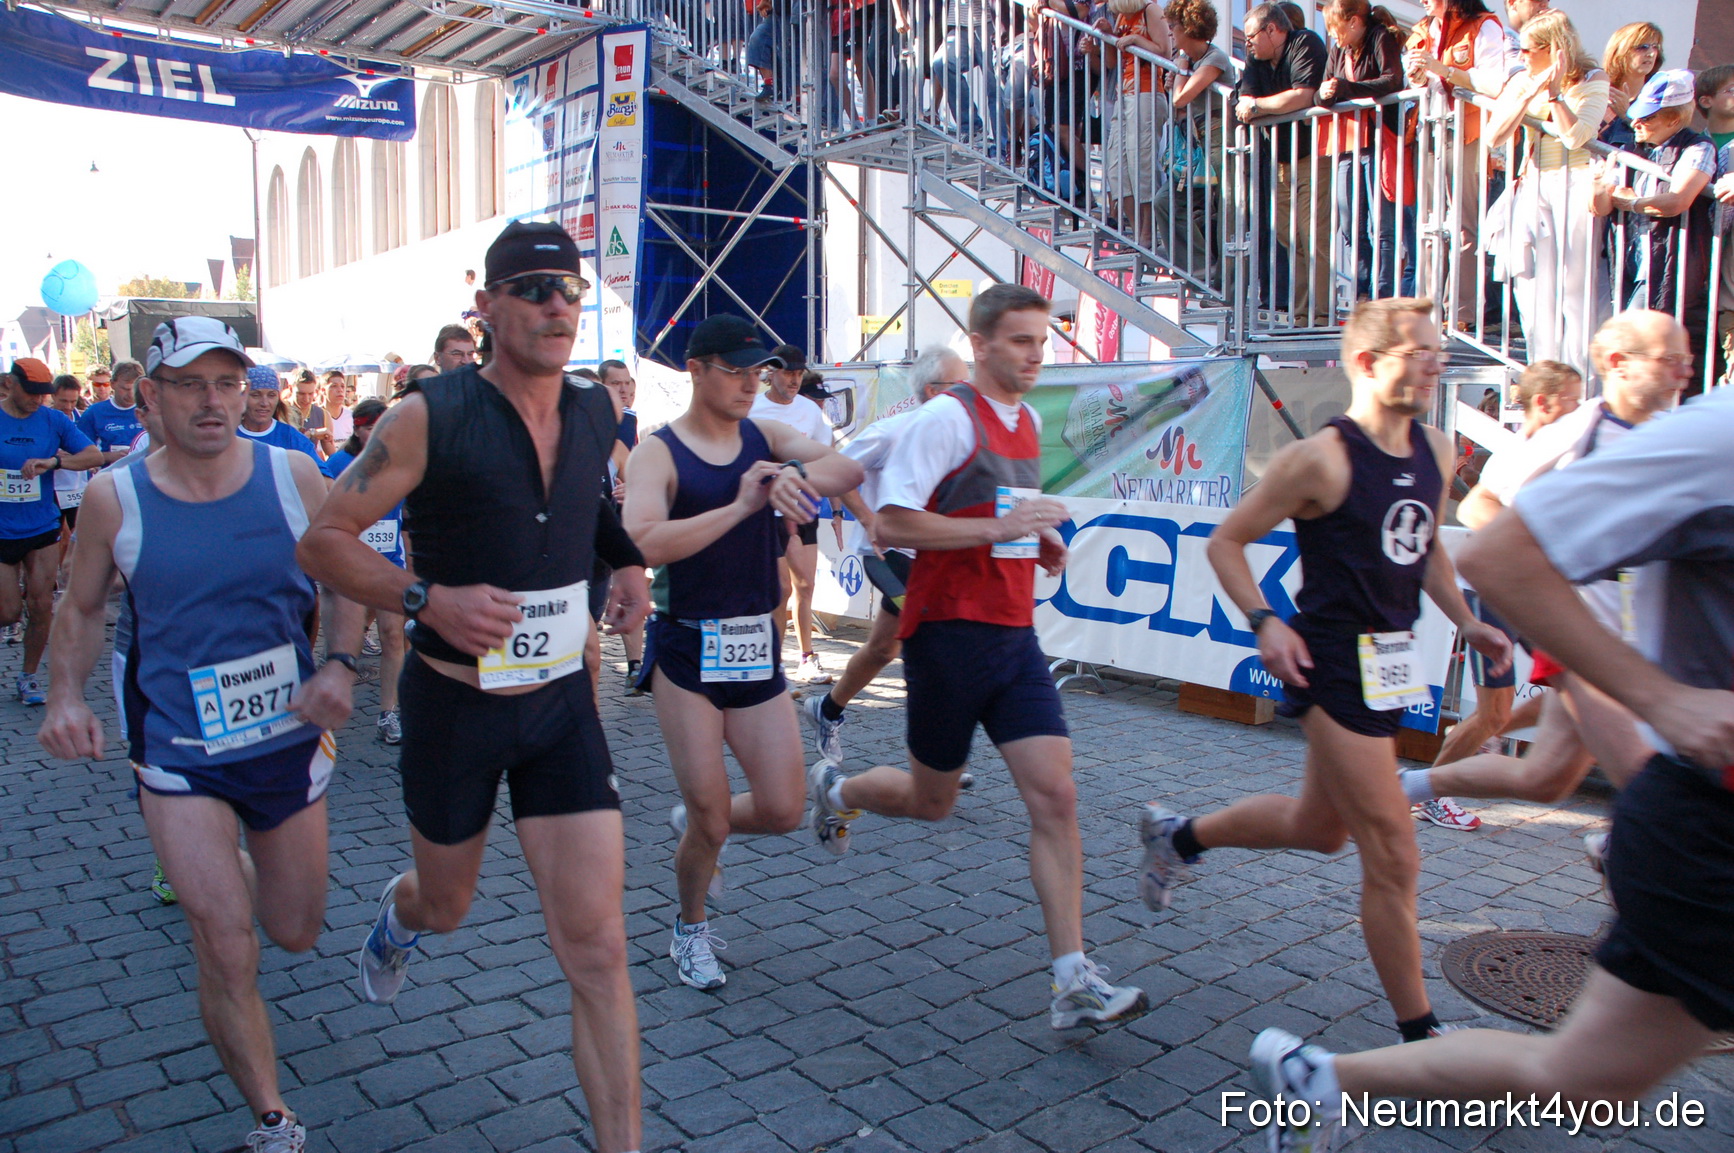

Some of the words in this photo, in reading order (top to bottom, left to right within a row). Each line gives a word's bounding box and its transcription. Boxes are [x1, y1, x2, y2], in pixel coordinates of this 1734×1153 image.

[85, 46, 236, 107] ZIEL
[8, 483, 31, 494] 512
[367, 532, 394, 543] 3539
[519, 600, 568, 619] rankie
[512, 631, 550, 658] 62
[723, 642, 768, 663] 3234
[220, 660, 276, 690] Oswald
[204, 700, 217, 716] A
[228, 681, 295, 724] 2877
